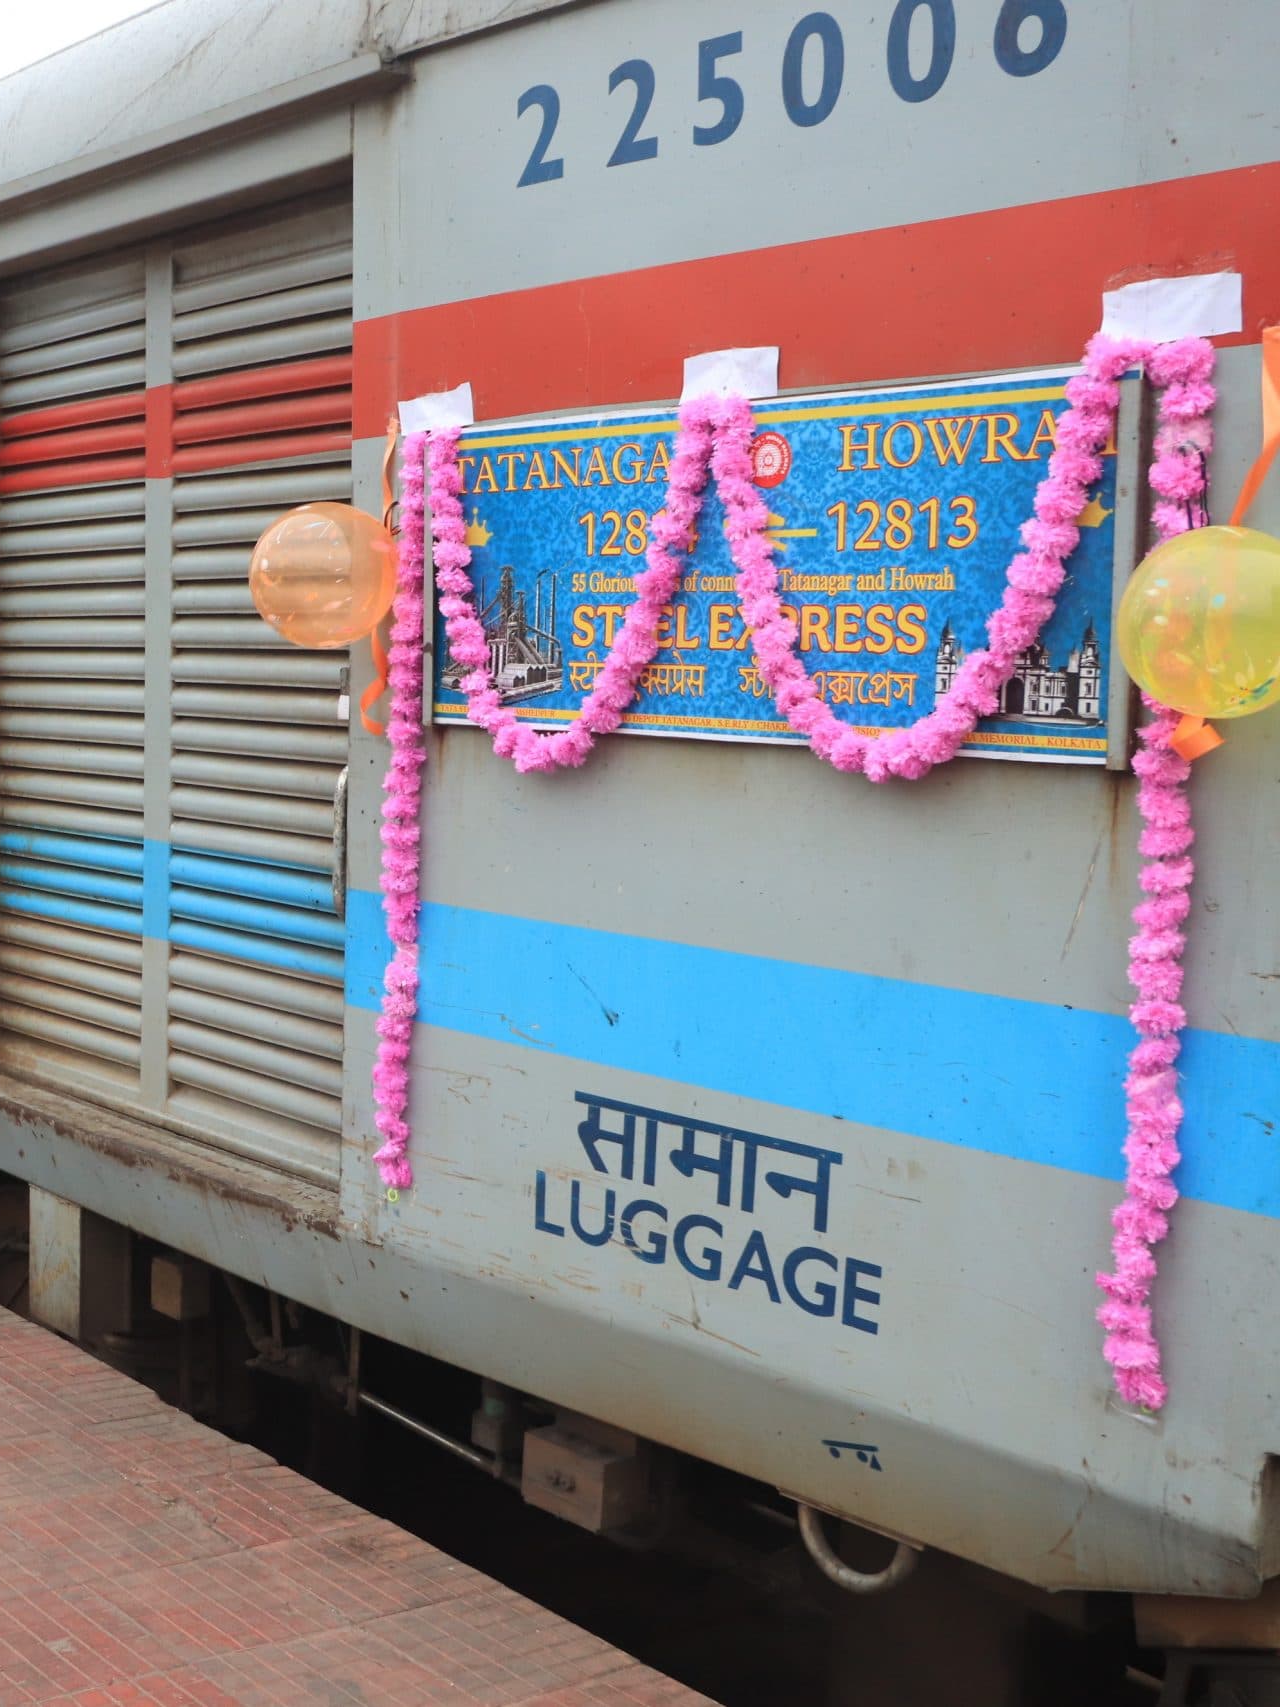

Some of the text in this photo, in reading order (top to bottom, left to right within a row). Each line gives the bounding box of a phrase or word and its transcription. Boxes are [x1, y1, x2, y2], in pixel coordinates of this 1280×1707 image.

[455, 407, 1118, 495] TATANAGA HOWRA
[827, 495, 980, 553] 12813
[572, 572, 588, 593] 55
[589, 571, 641, 593] Gloriou
[683, 570, 700, 593] of
[778, 568, 854, 597] Tatanagar
[856, 567, 885, 592] and
[890, 566, 956, 592] Howrah
[571, 603, 701, 650] STEL
[980, 733, 1038, 746] MEMORIAL
[1047, 737, 1102, 749] KOLKATA
[575, 1090, 844, 1233] सामान
[534, 1169, 883, 1336] LUGGAGE
